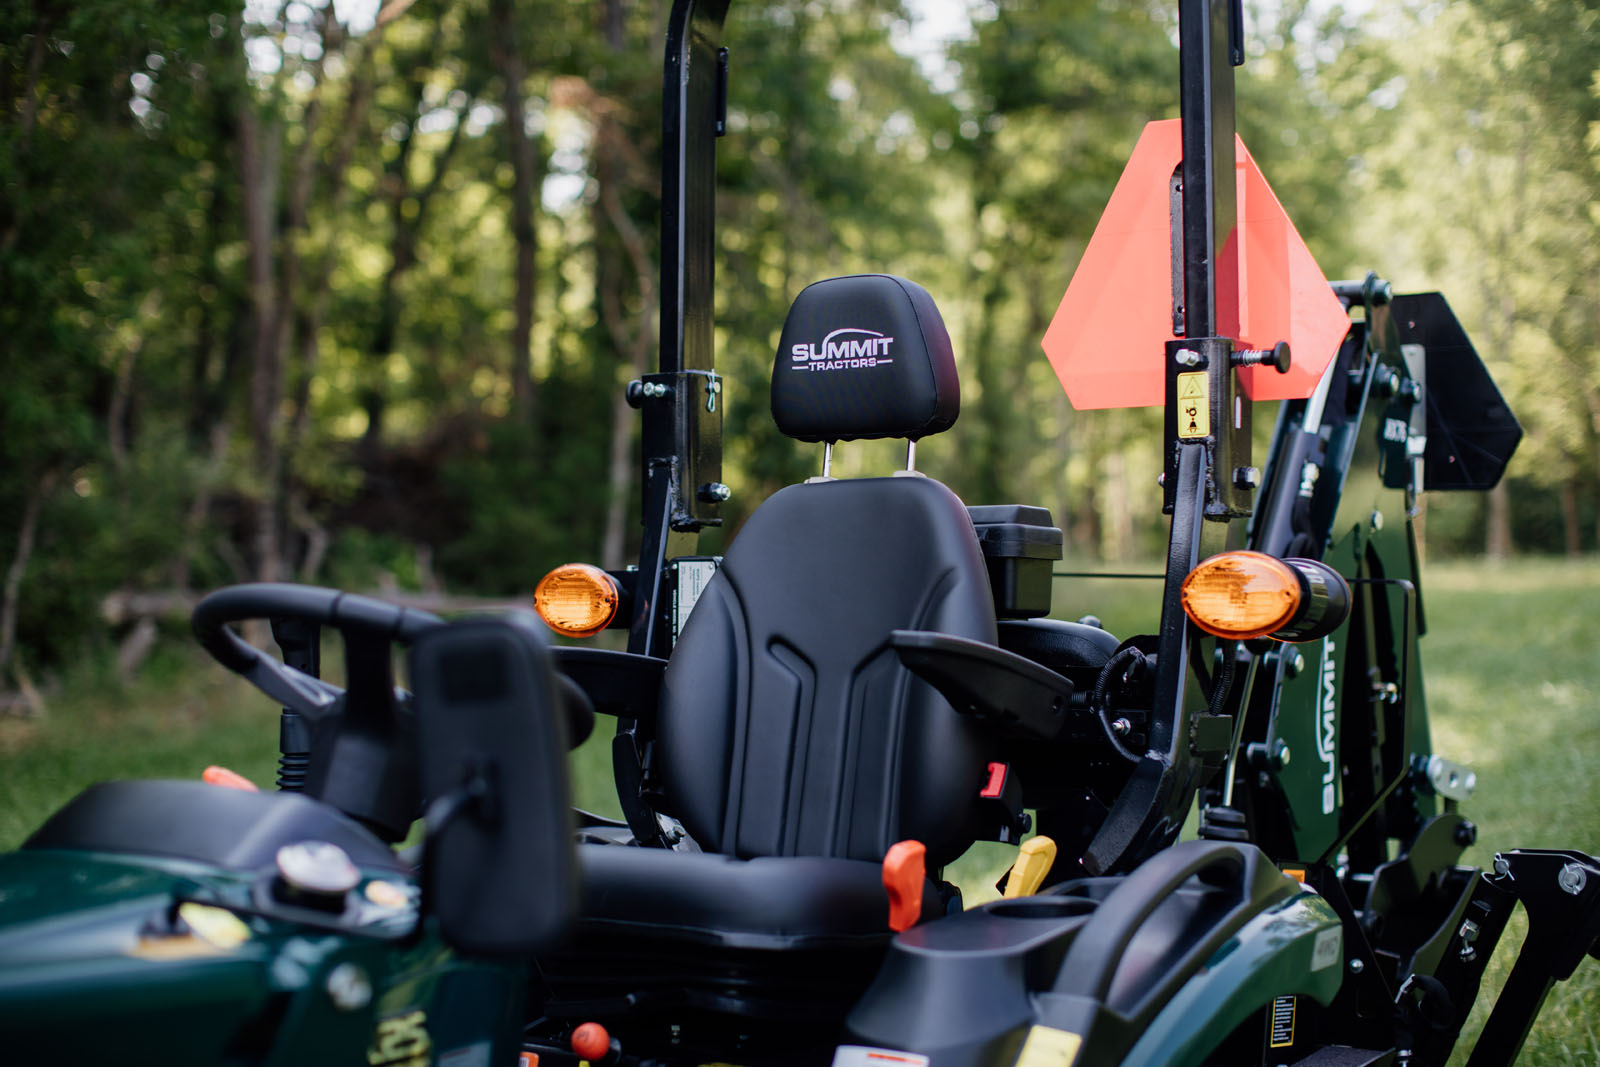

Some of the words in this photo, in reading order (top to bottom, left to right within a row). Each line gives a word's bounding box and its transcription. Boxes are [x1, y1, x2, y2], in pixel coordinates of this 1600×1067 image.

[792, 328, 894, 361] SUMMIT
[808, 357, 877, 371] TRACTORS
[1315, 634, 1336, 815] SUMMIT
